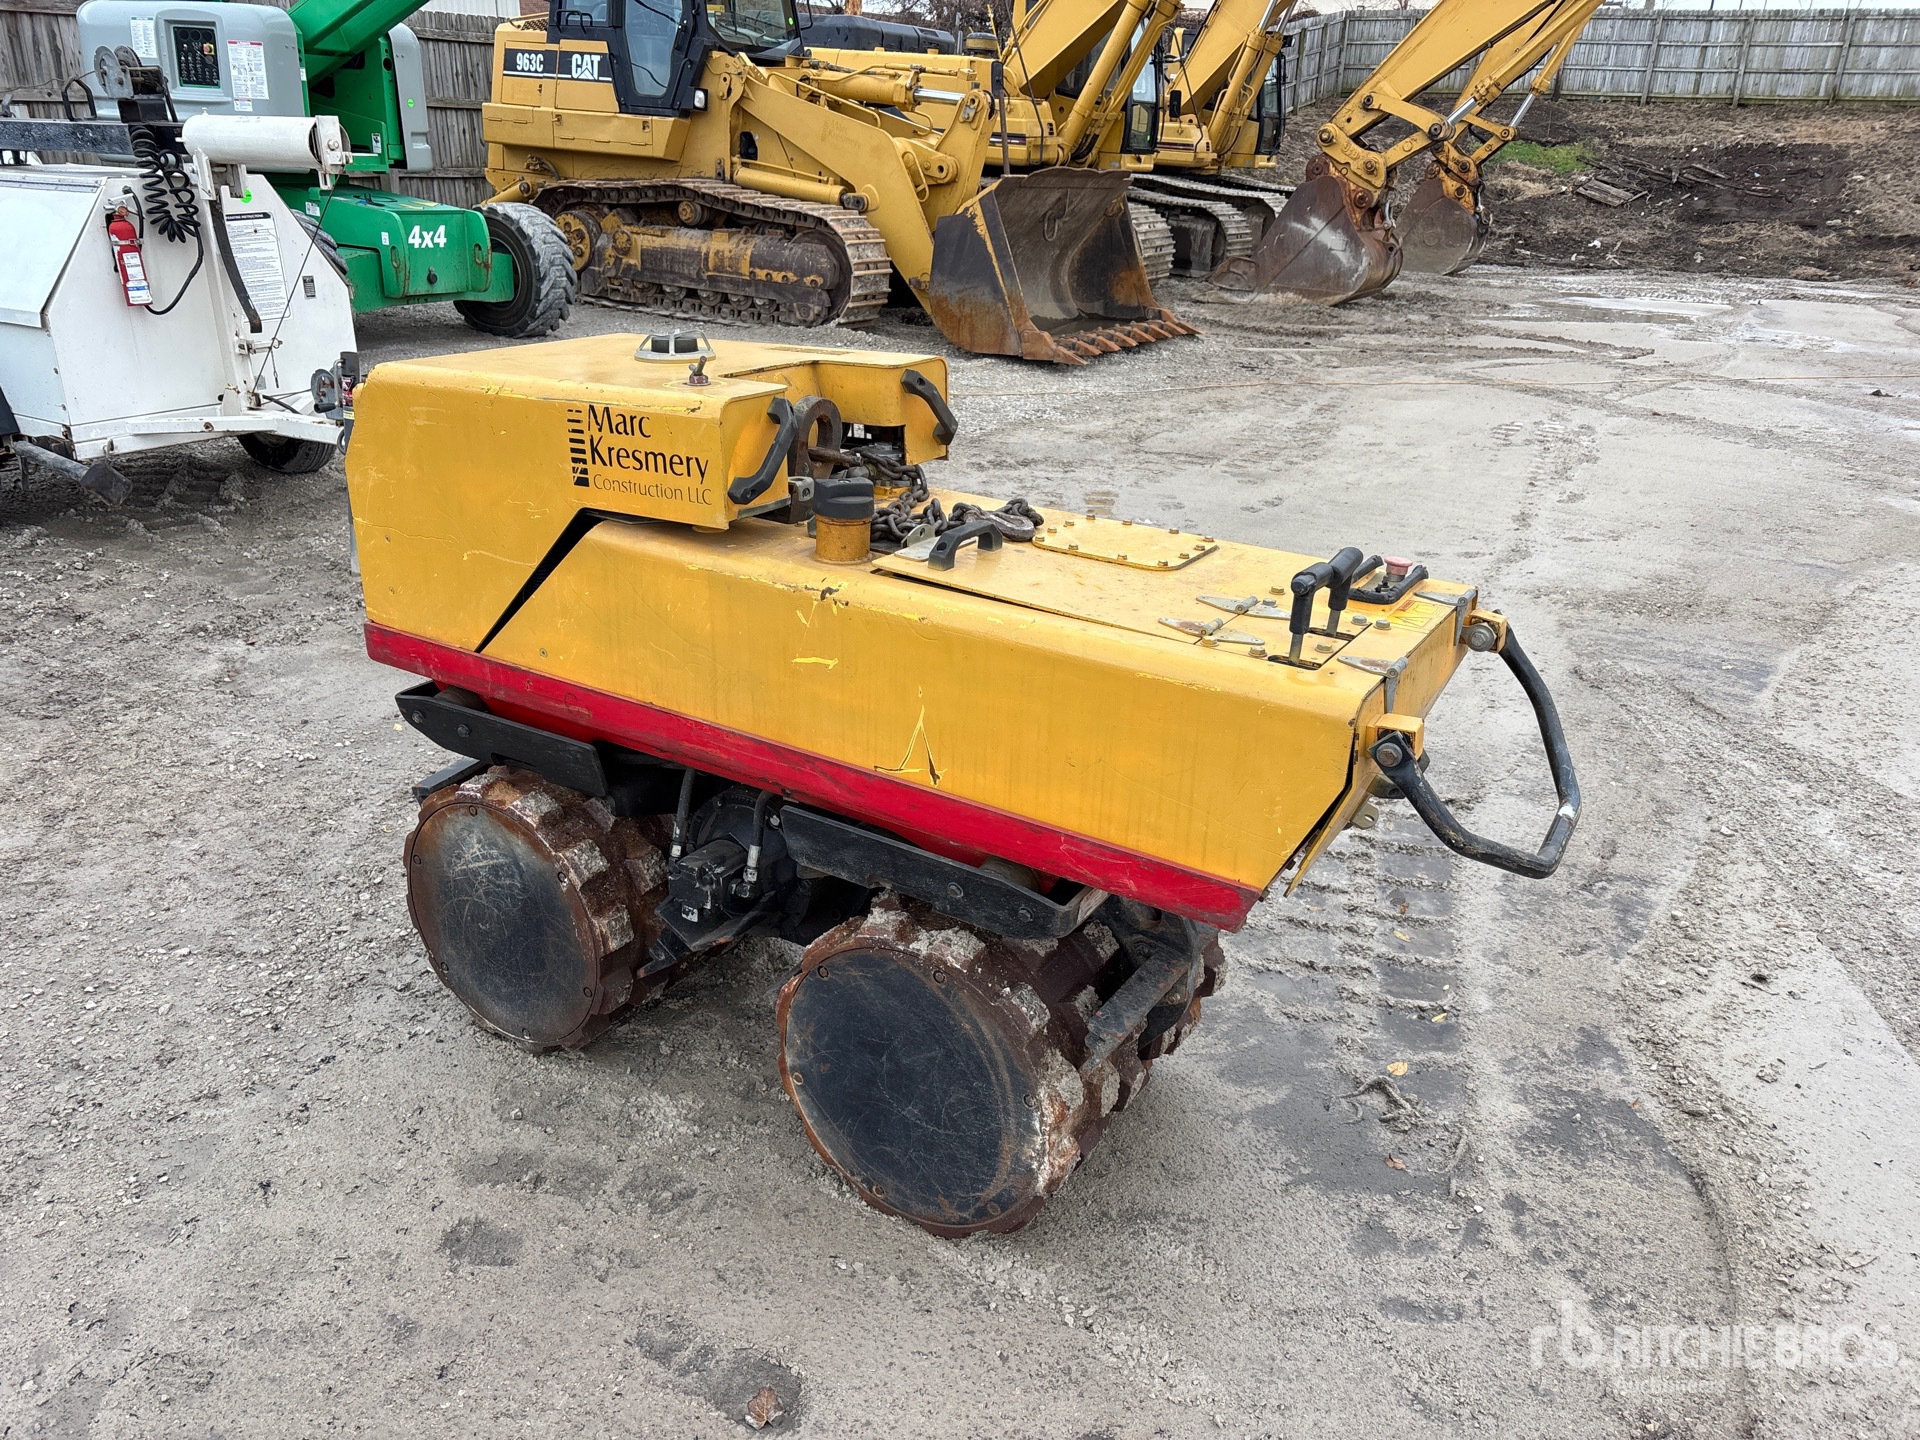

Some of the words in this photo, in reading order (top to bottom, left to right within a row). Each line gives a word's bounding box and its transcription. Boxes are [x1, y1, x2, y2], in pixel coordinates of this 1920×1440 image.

[516, 52, 544, 72] 963C
[571, 53, 601, 80] CAT
[407, 224, 447, 249] 4x4
[587, 404, 651, 438] Marc
[589, 434, 709, 485] Kresmery
[593, 474, 683, 501] Construction
[688, 486, 712, 506] LLC
